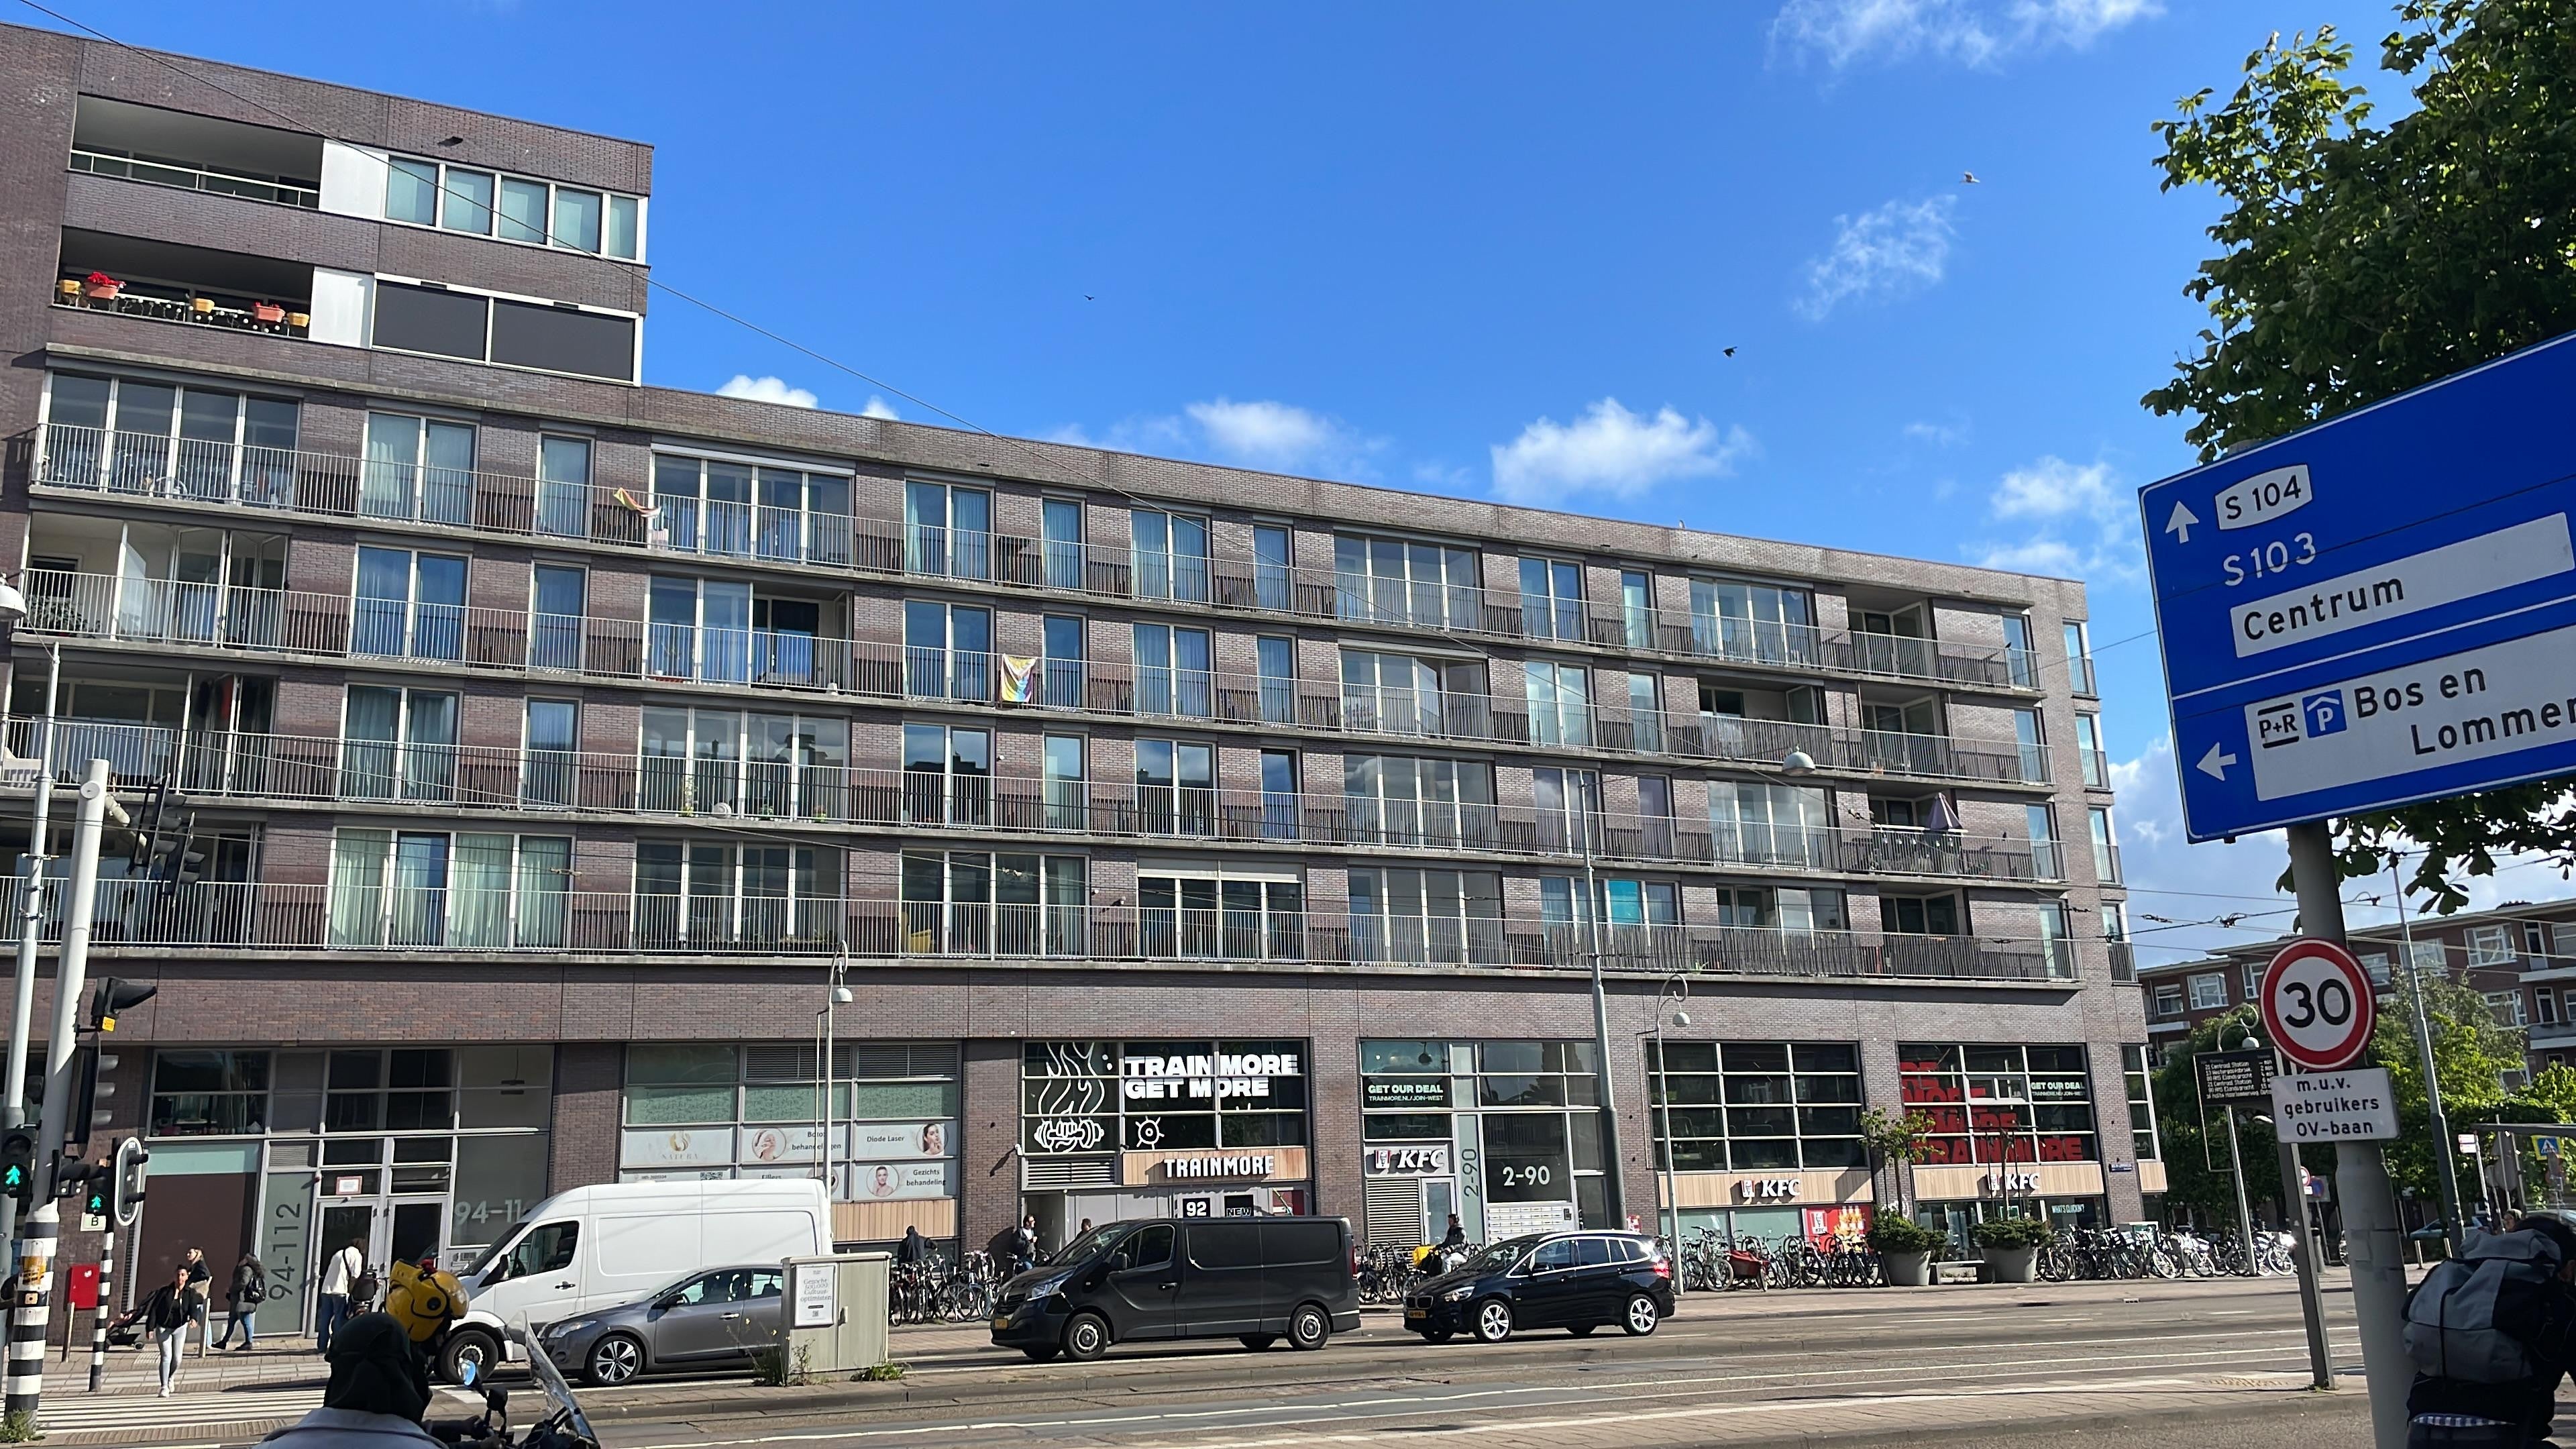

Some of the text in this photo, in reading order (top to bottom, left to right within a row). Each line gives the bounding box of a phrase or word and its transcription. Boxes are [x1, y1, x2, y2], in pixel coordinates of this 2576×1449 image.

[2225, 474, 2301, 519] S 104
[2244, 578, 2404, 640] Centrum
[2354, 667, 2486, 718] Bos en
[2259, 713, 2298, 739] P+R
[2317, 707, 2334, 731] P
[2284, 979, 2351, 1028] 30
[1124, 1054, 1298, 1076] TRAIN MORE
[1124, 1077, 1269, 1099] GET MORE
[1368, 1084, 1444, 1093] GET OUR DEAL
[2031, 1081, 2086, 1090] GET OUR DEAL
[2296, 1077, 2351, 1092] m.u.v.
[2284, 1097, 2379, 1119] gebruikers
[2296, 1121, 2373, 1136] OV-baan
[1163, 1155, 1275, 1178] TRAINMORE
[1397, 1149, 1446, 1169] KFC
[906, 1179, 947, 1187] behandeling
[1462, 1148, 1479, 1197] 2-90
[1503, 1165, 1550, 1187] 2-90
[2006, 1173, 2041, 1190] KFC
[1761, 1179, 1801, 1197] KFC
[455, 1198, 522, 1224] 94-11
[1186, 1201, 1207, 1216] 92
[1227, 1208, 1252, 1216] NEW
[91, 1217, 99, 1226] B
[269, 1203, 301, 1300] 94-112
